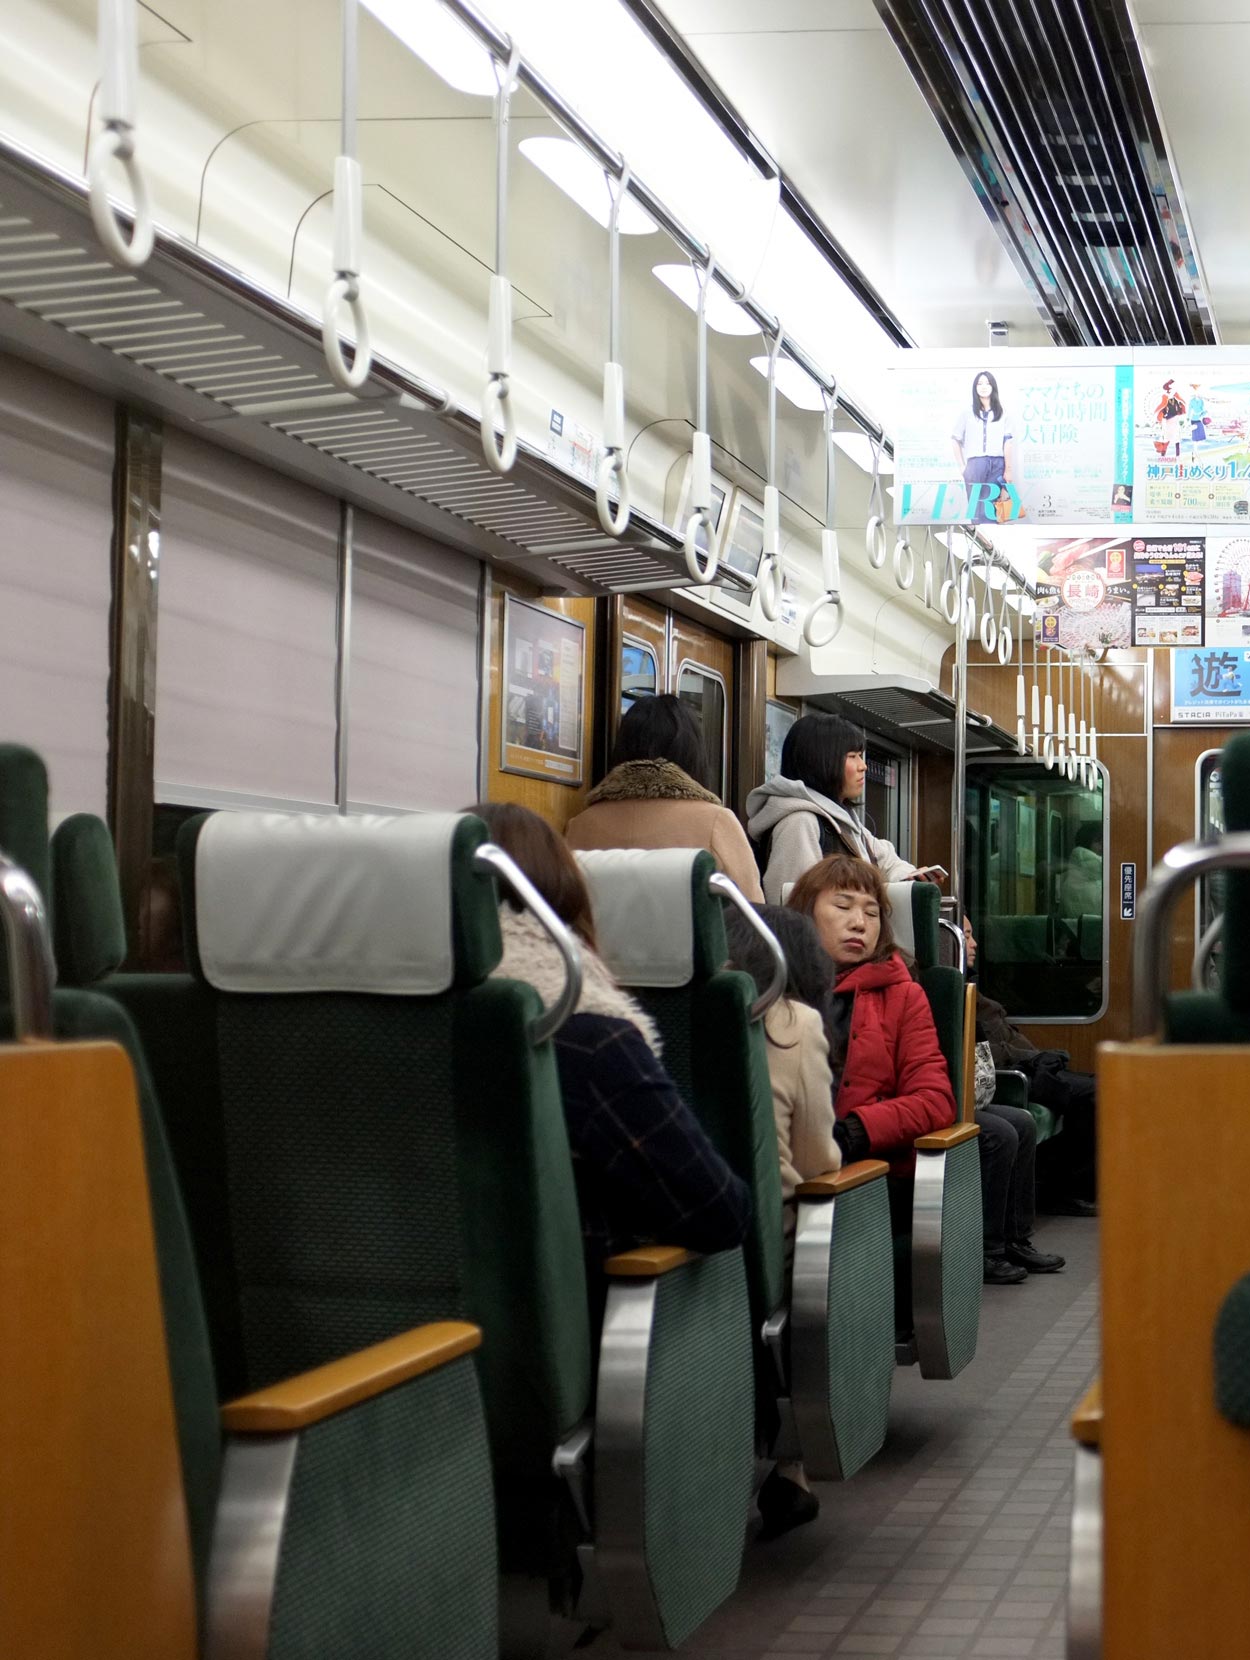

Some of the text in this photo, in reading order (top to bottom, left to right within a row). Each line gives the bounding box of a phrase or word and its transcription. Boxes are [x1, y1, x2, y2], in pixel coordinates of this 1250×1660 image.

[898, 482, 1039, 521] VERY
[1067, 584, 1100, 599] 長崎
[1189, 651, 1243, 698] 遊
[1178, 711, 1211, 719] STACIA
[1123, 866, 1133, 900] 優先座席
